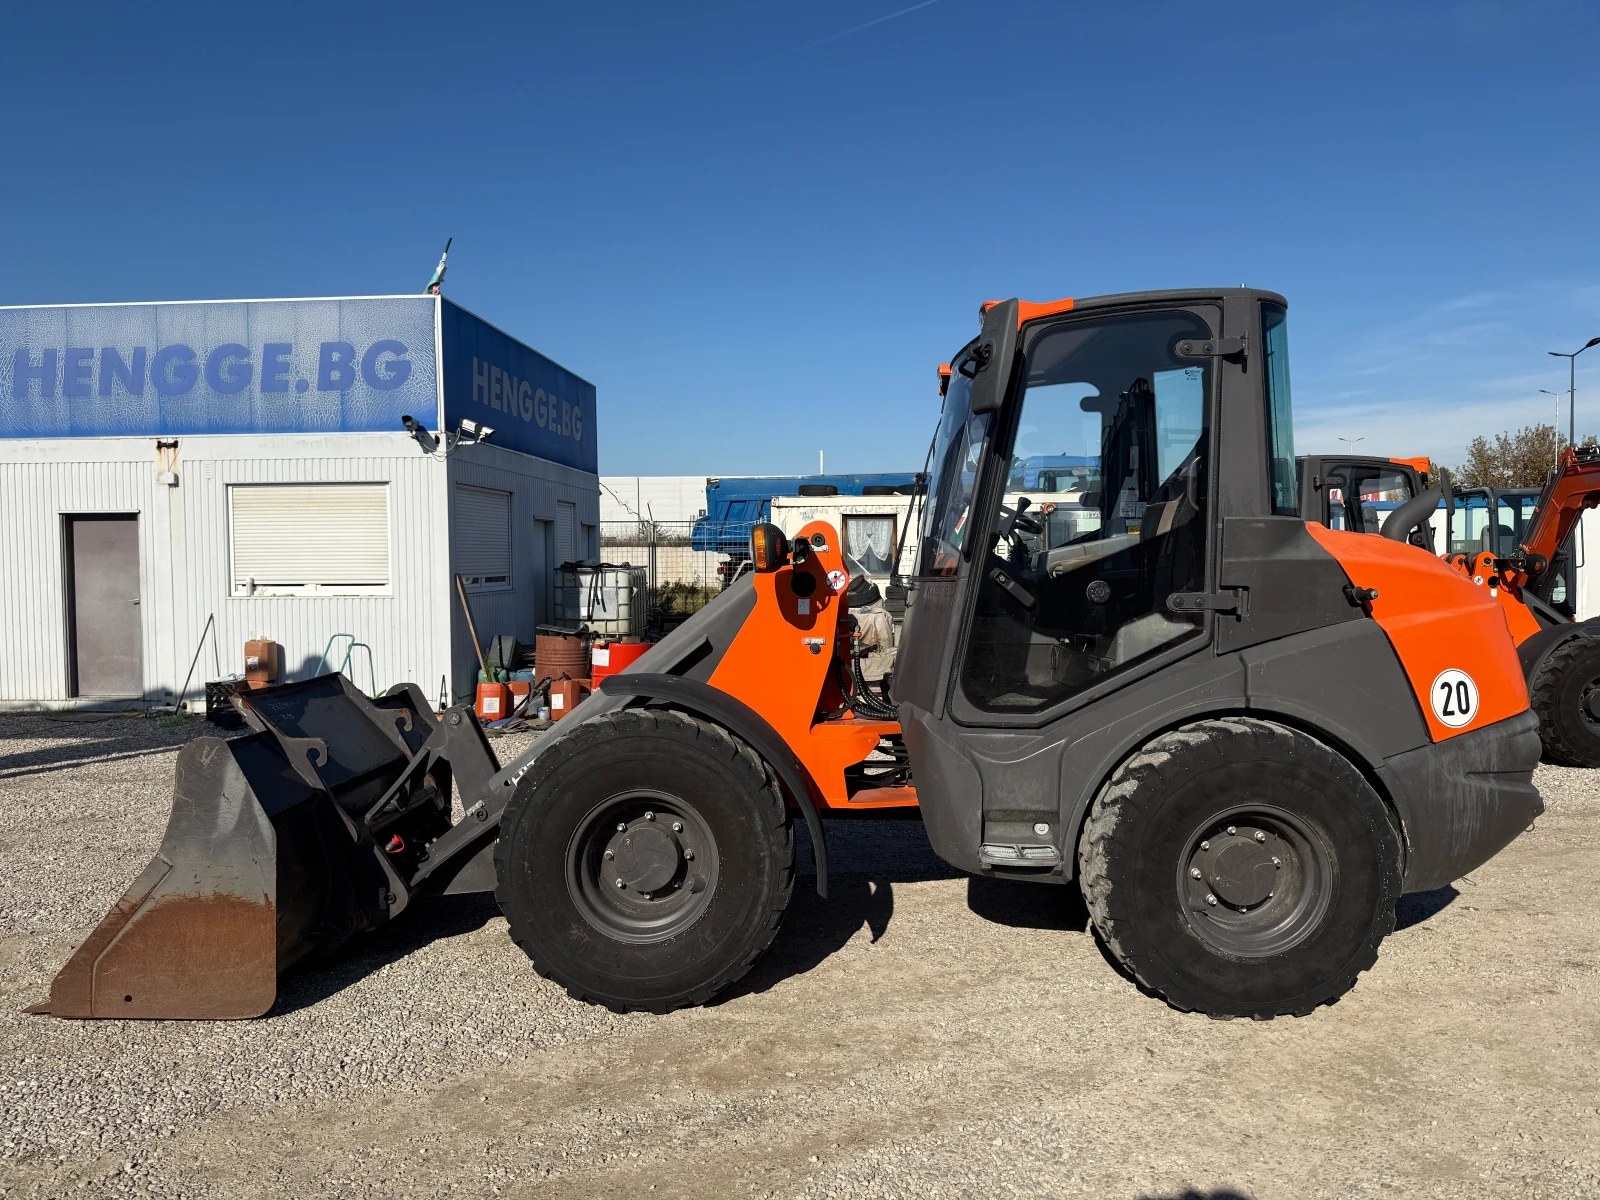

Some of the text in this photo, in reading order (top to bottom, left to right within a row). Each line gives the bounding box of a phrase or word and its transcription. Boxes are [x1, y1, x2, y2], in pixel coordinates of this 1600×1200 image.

[13, 339, 412, 398] HENGGE.BG
[472, 355, 583, 441] HENGGE.BG
[1440, 680, 1470, 716] 20
